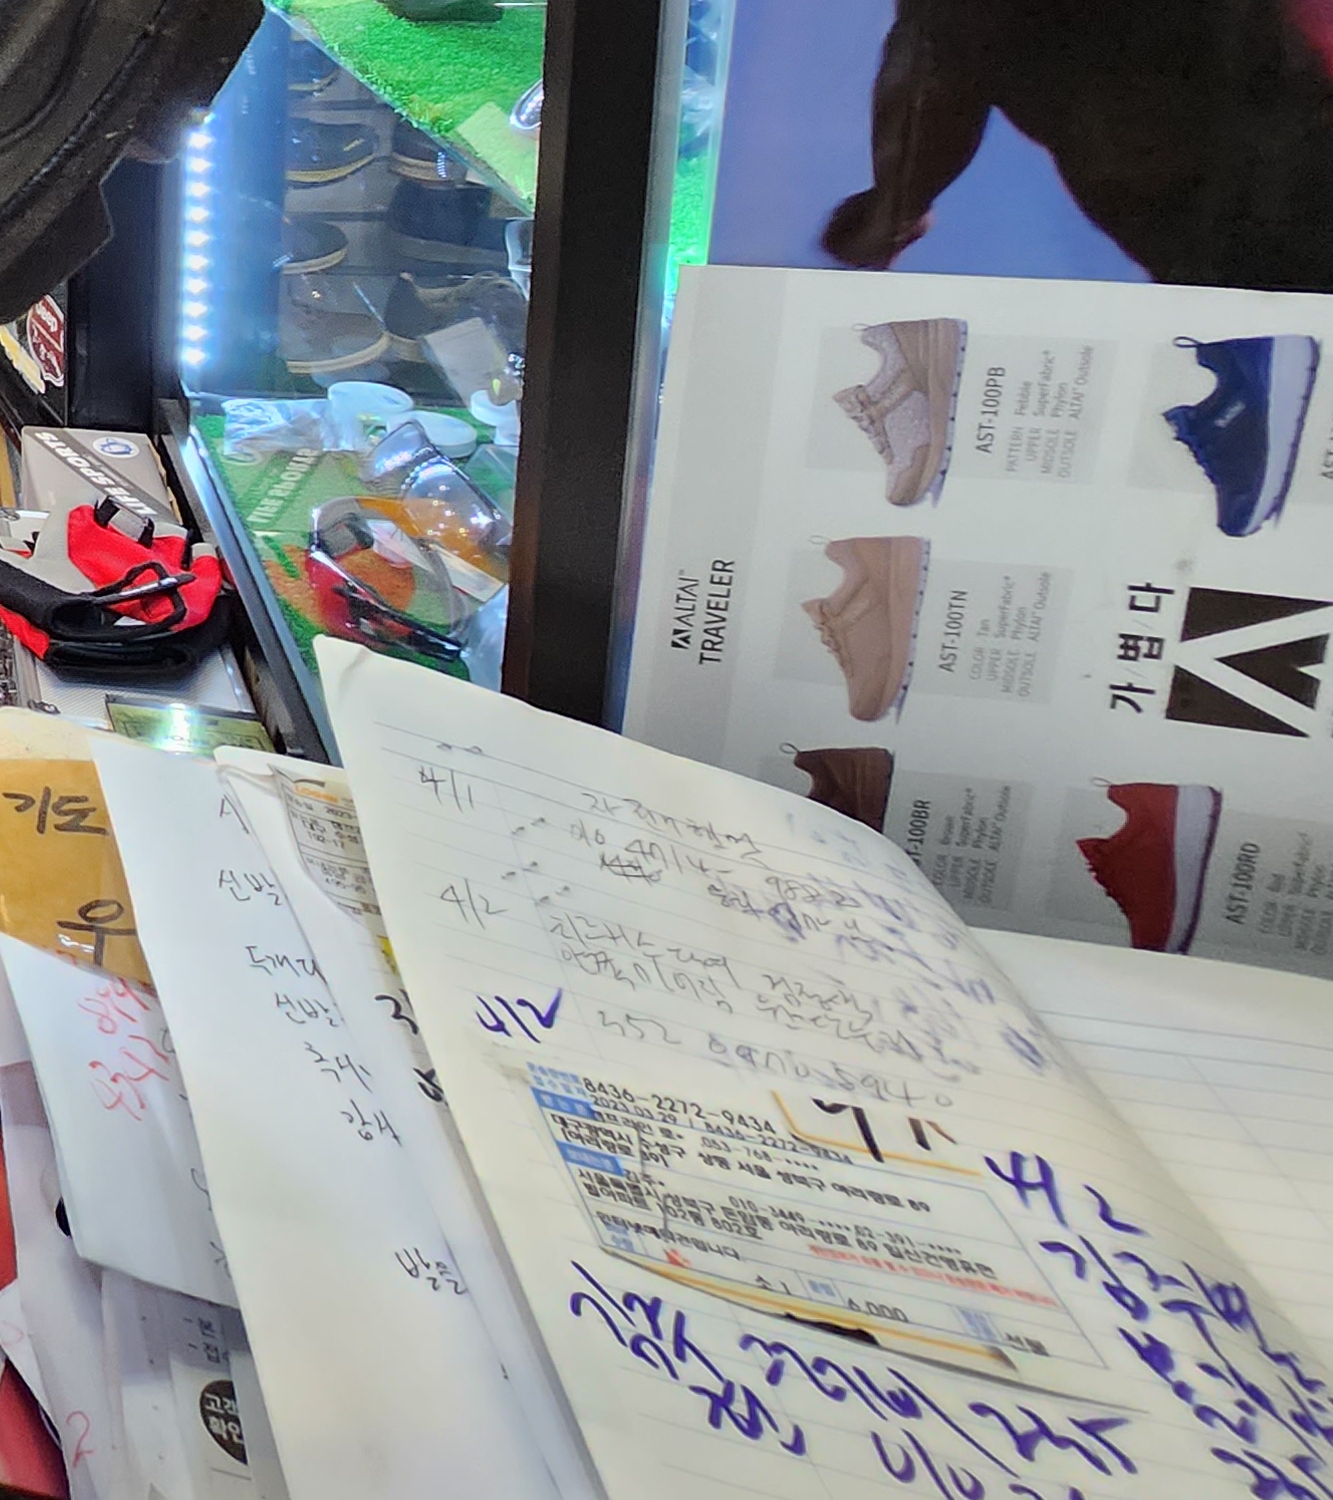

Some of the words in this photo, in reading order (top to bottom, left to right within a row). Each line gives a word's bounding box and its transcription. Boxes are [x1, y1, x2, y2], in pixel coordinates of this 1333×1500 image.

[975, 366, 1006, 454] AST-100PB
[35, 430, 114, 494] SPORTS
[107, 487, 158, 517] LIFE
[673, 576, 700, 628] ALTAI
[699, 559, 735, 665] TRAVELER
[937, 589, 969, 673] AST-100TN
[581, 1076, 778, 1136] 8436-2272-9434
